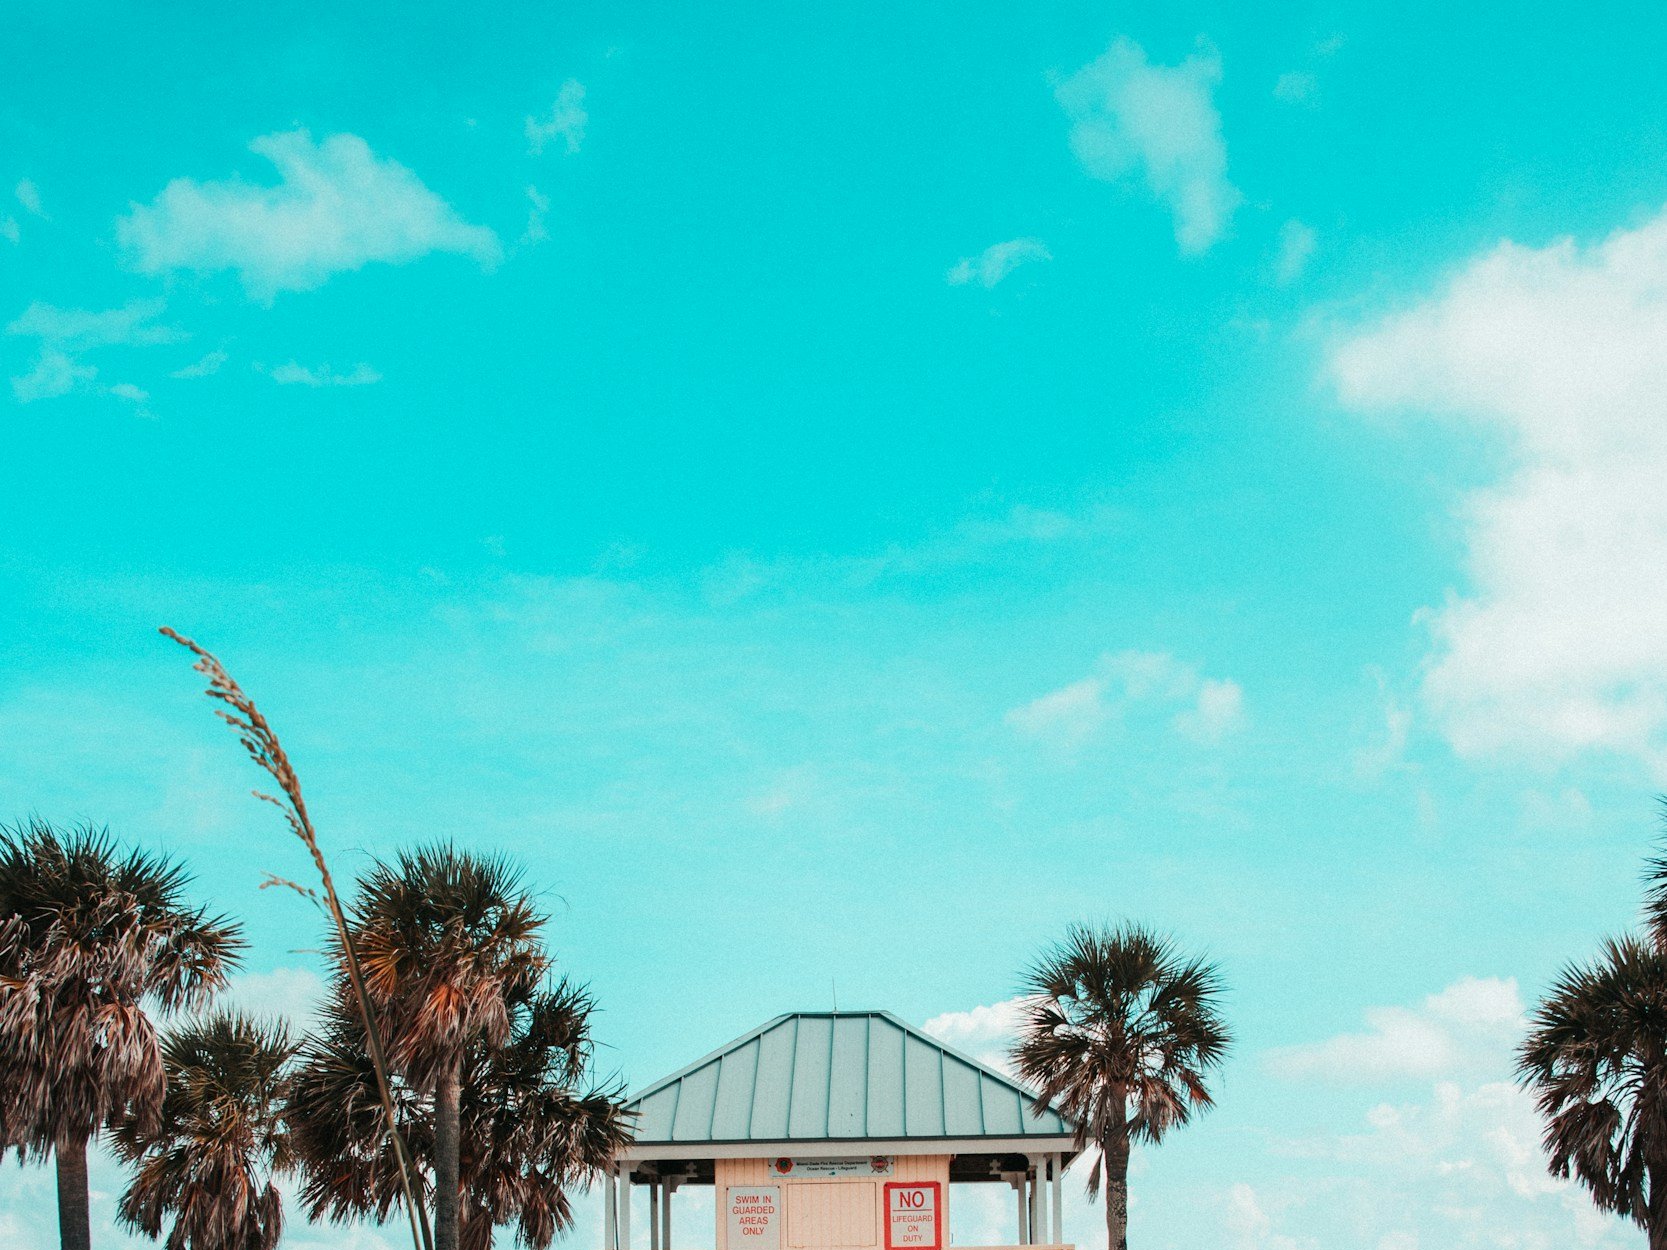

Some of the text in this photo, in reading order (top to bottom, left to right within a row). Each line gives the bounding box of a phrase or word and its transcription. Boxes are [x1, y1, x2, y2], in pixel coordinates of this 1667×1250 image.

[736, 1196, 772, 1204] SWIM IN
[900, 1191, 924, 1208] NO
[732, 1206, 774, 1214] GUARDED
[739, 1216, 768, 1224] AREAS
[742, 1227, 764, 1236] ONLY
